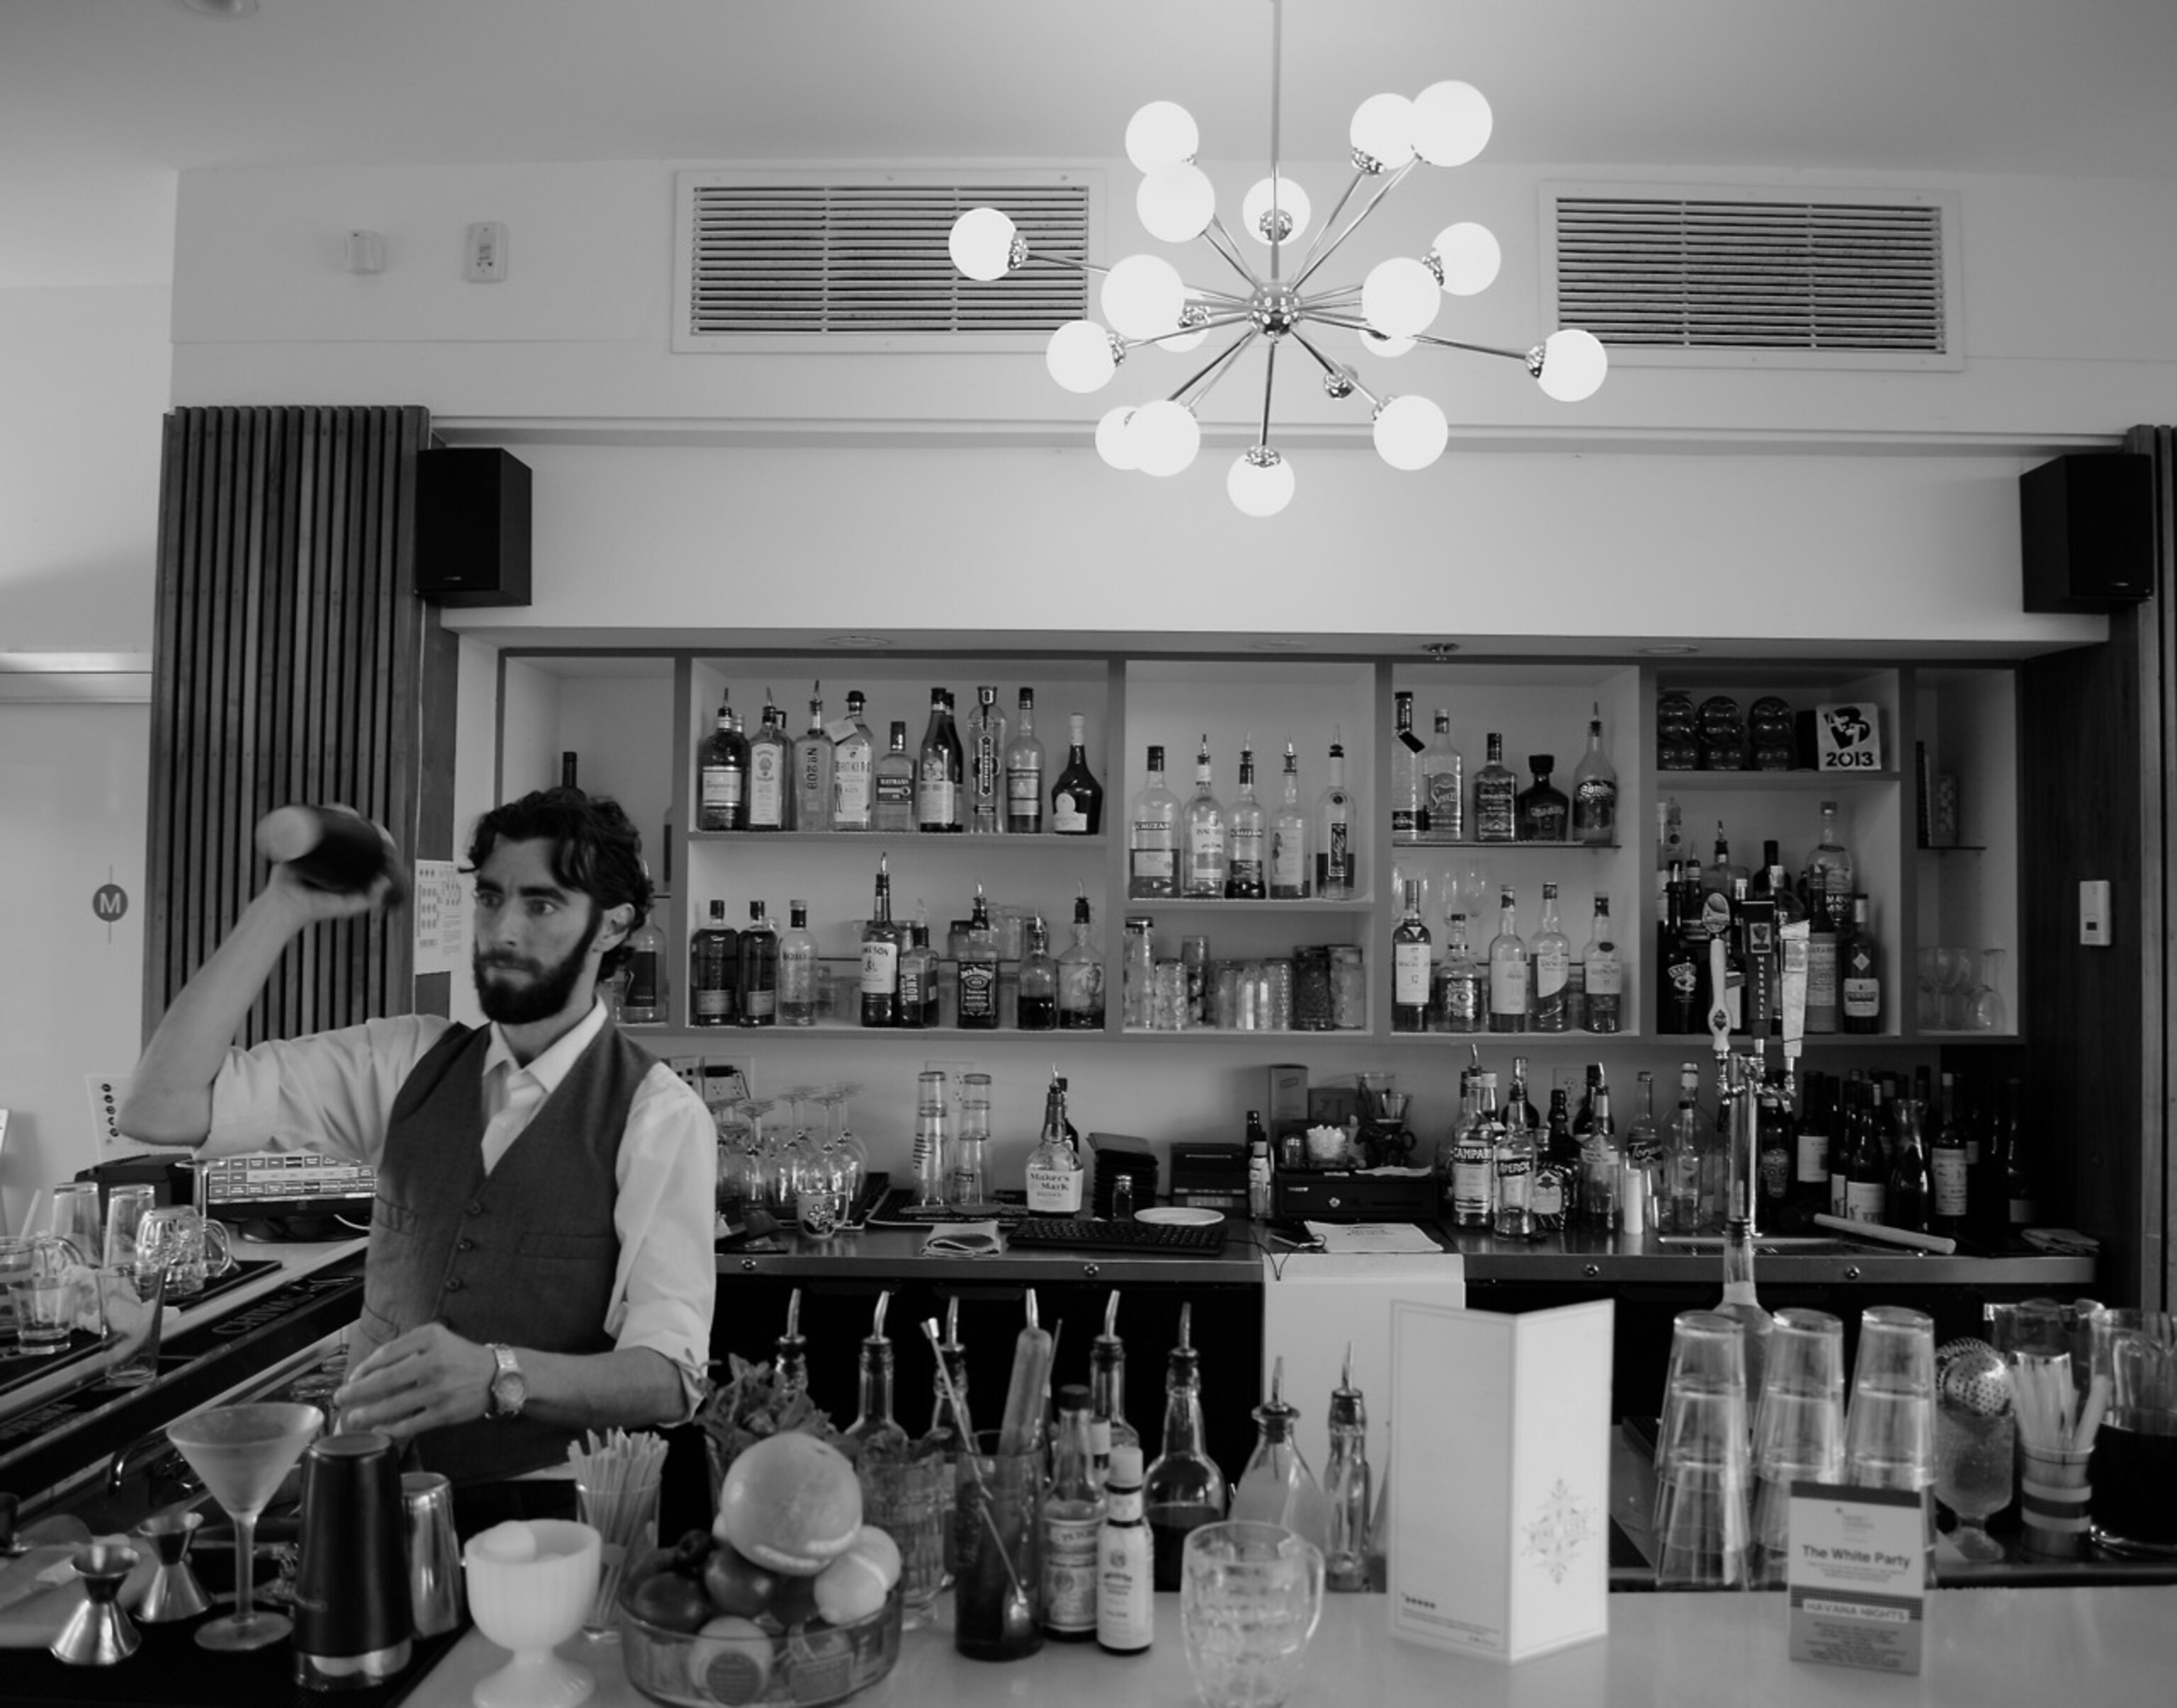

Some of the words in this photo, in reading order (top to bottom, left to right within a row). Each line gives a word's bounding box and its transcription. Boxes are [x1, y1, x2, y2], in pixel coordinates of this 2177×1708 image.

[1825, 751, 1874, 768] 2013
[99, 892, 121, 914] M
[906, 972, 919, 1001] KNOB
[1757, 956, 1765, 1021] MARSHALL
[1041, 1182, 1069, 1192] Mark
[1801, 1544, 1828, 1560] The
[1831, 1548, 1872, 1564] White
[1874, 1552, 1911, 1569] Party
[1806, 1601, 1857, 1617] HAVANA
[1860, 1606, 1906, 1622] NIGHTS
